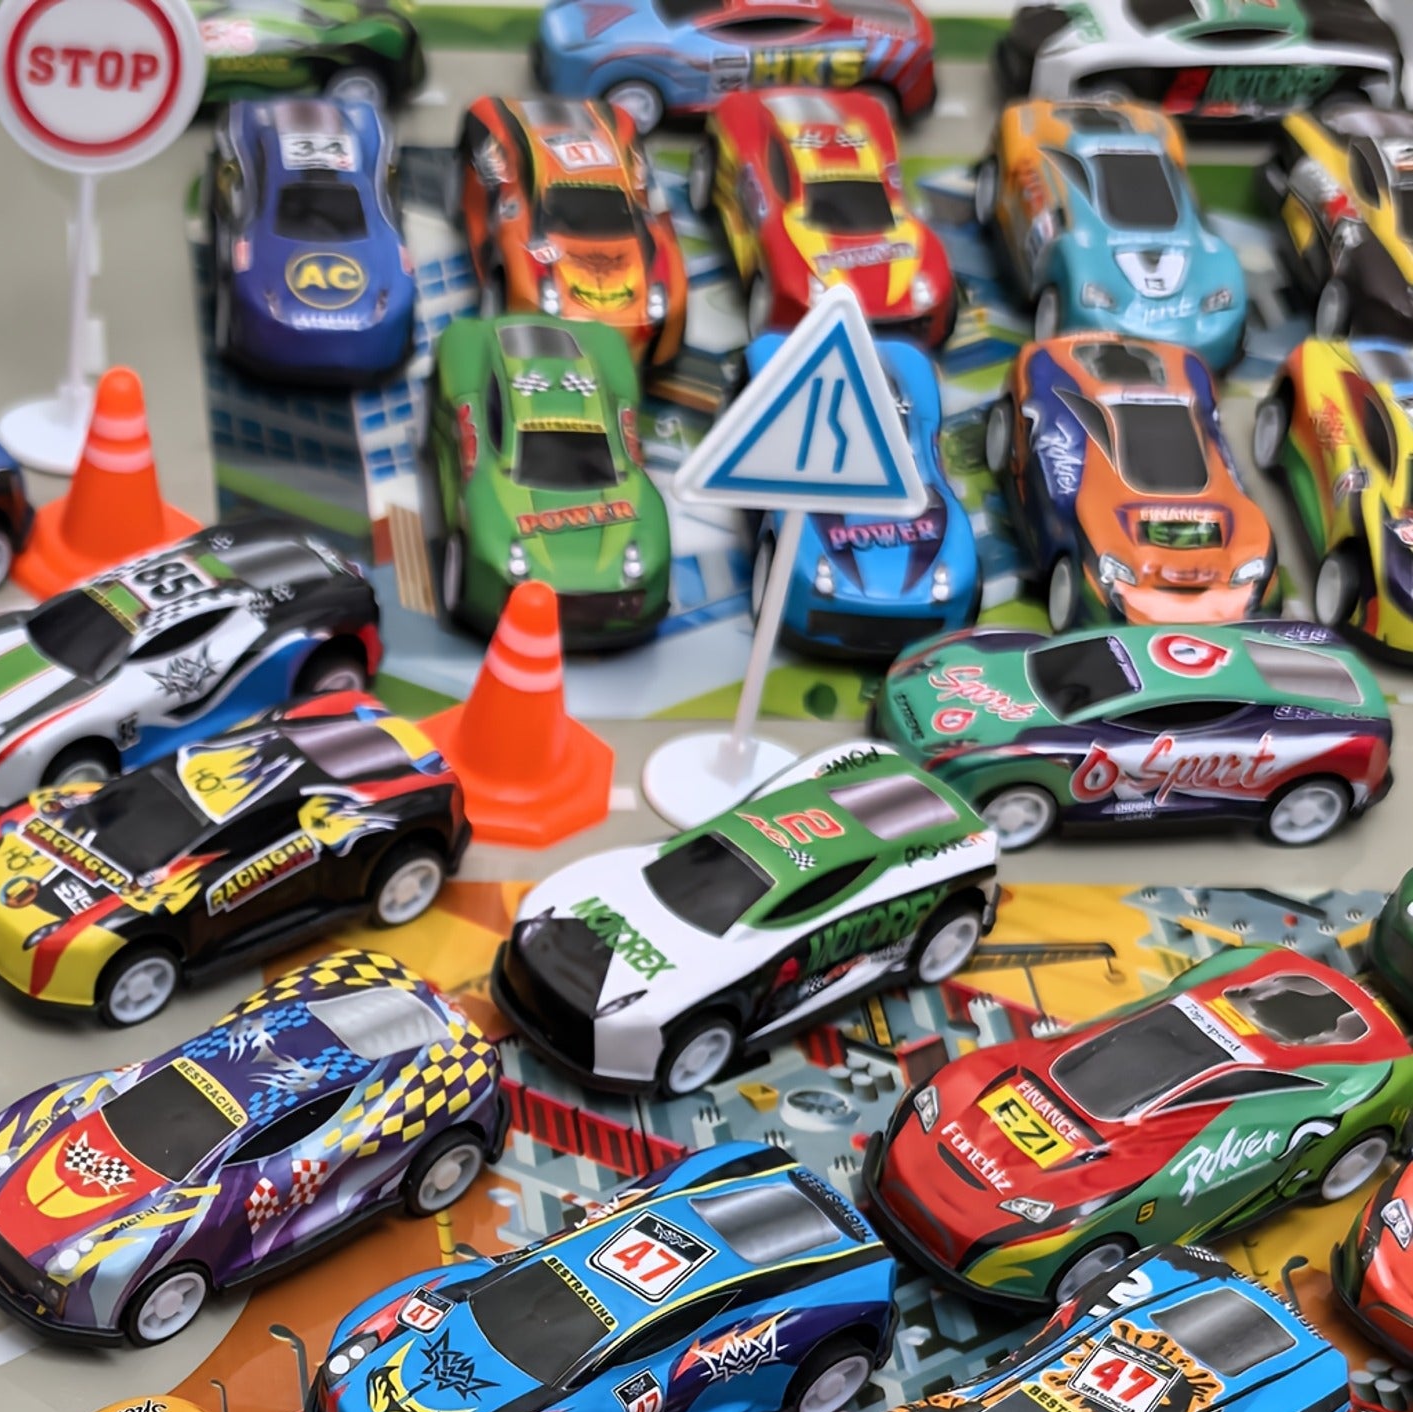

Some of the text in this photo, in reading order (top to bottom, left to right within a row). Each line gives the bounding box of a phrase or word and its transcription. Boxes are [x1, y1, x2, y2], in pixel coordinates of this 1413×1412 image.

[28, 46, 161, 92] STOP
[562, 144, 599, 167] 47
[295, 263, 364, 291] AC
[516, 500, 638, 538] POWER
[828, 518, 940, 553] POWER
[134, 560, 203, 600] 85
[929, 666, 1038, 721] Sport
[190, 766, 228, 798] HOT
[1121, 731, 1277, 807] Sport
[773, 808, 846, 843] 2
[5, 842, 36, 875] HOT
[569, 895, 677, 982] MOTOREX
[1184, 1002, 1243, 1053] Top-speed
[177, 1060, 245, 1126] BESTRACING
[1015, 1080, 1083, 1145] FINANCE
[997, 1097, 1059, 1156] EZI
[612, 1239, 682, 1284] 47
[547, 1256, 616, 1328] BESTRACING
[406, 1304, 441, 1327] 47
[1090, 1356, 1159, 1403] 47
